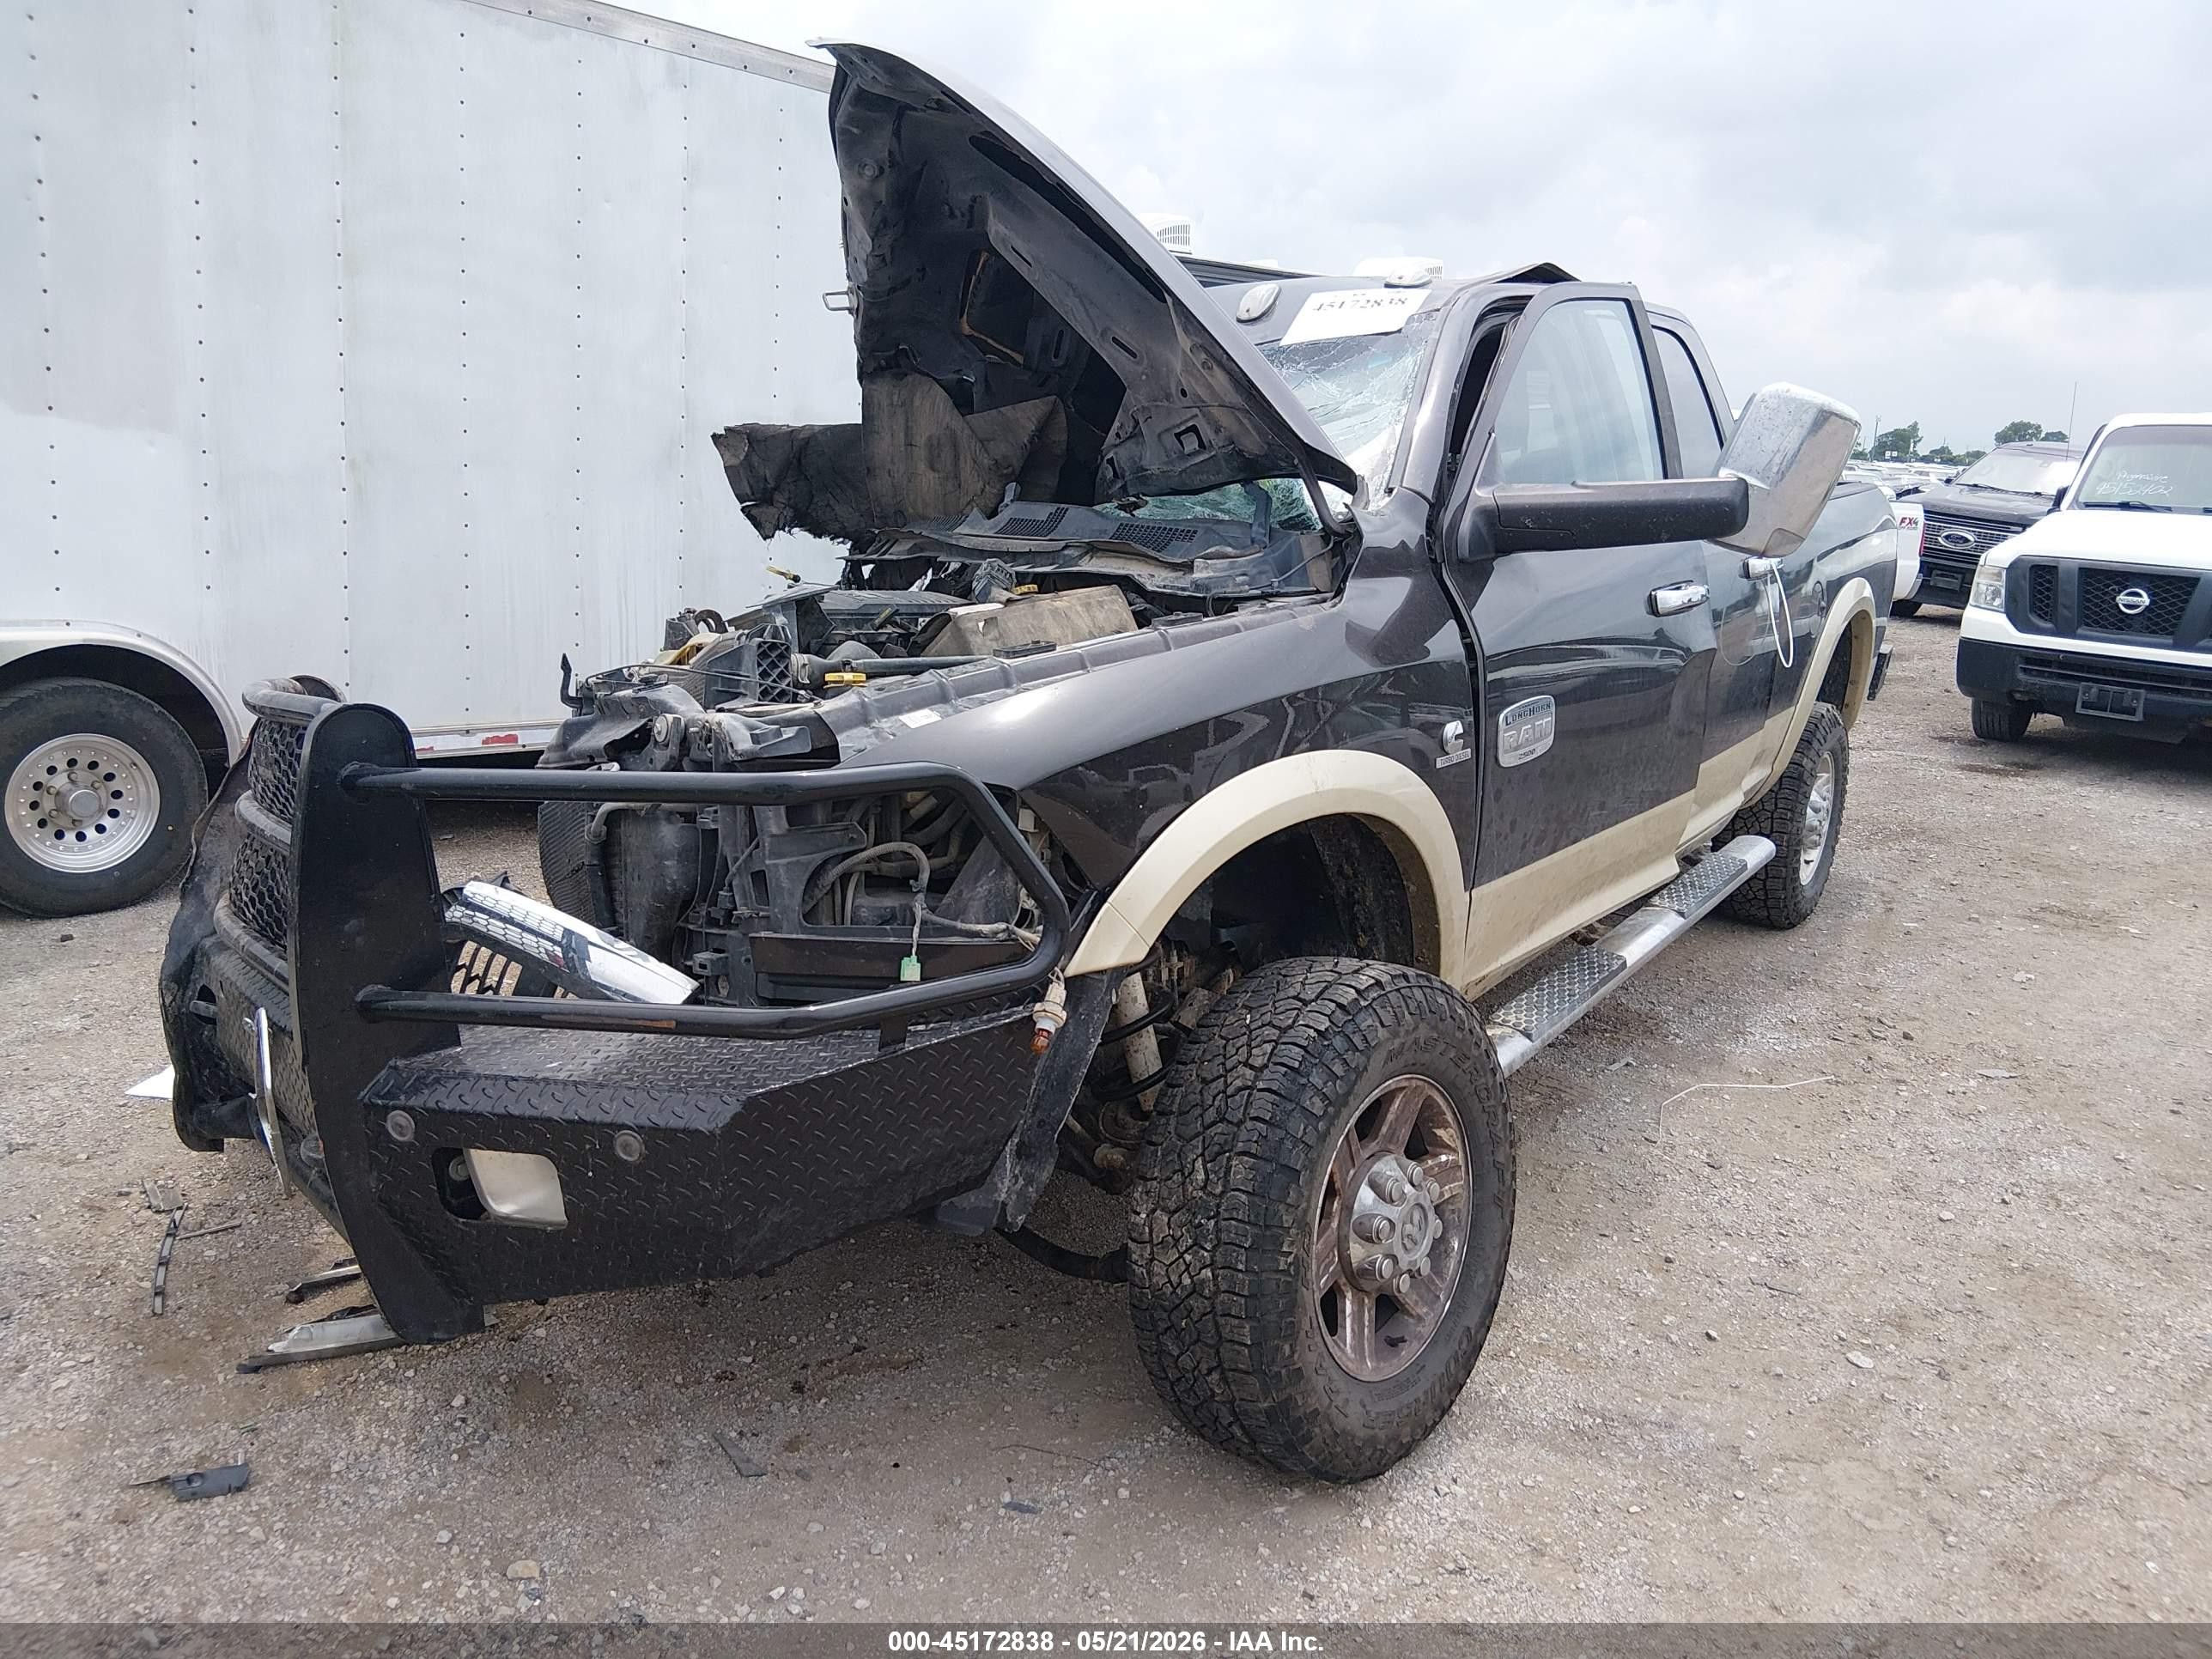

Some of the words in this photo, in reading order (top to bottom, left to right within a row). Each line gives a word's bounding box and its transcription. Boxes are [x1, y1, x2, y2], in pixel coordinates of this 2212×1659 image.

[1899, 517, 1919, 526] FX4
[1504, 717, 1552, 750] RAM
[1439, 755, 1455, 767] TURBO
[1455, 750, 1470, 763] DIESEL
[1518, 748, 1535, 760] 2500
